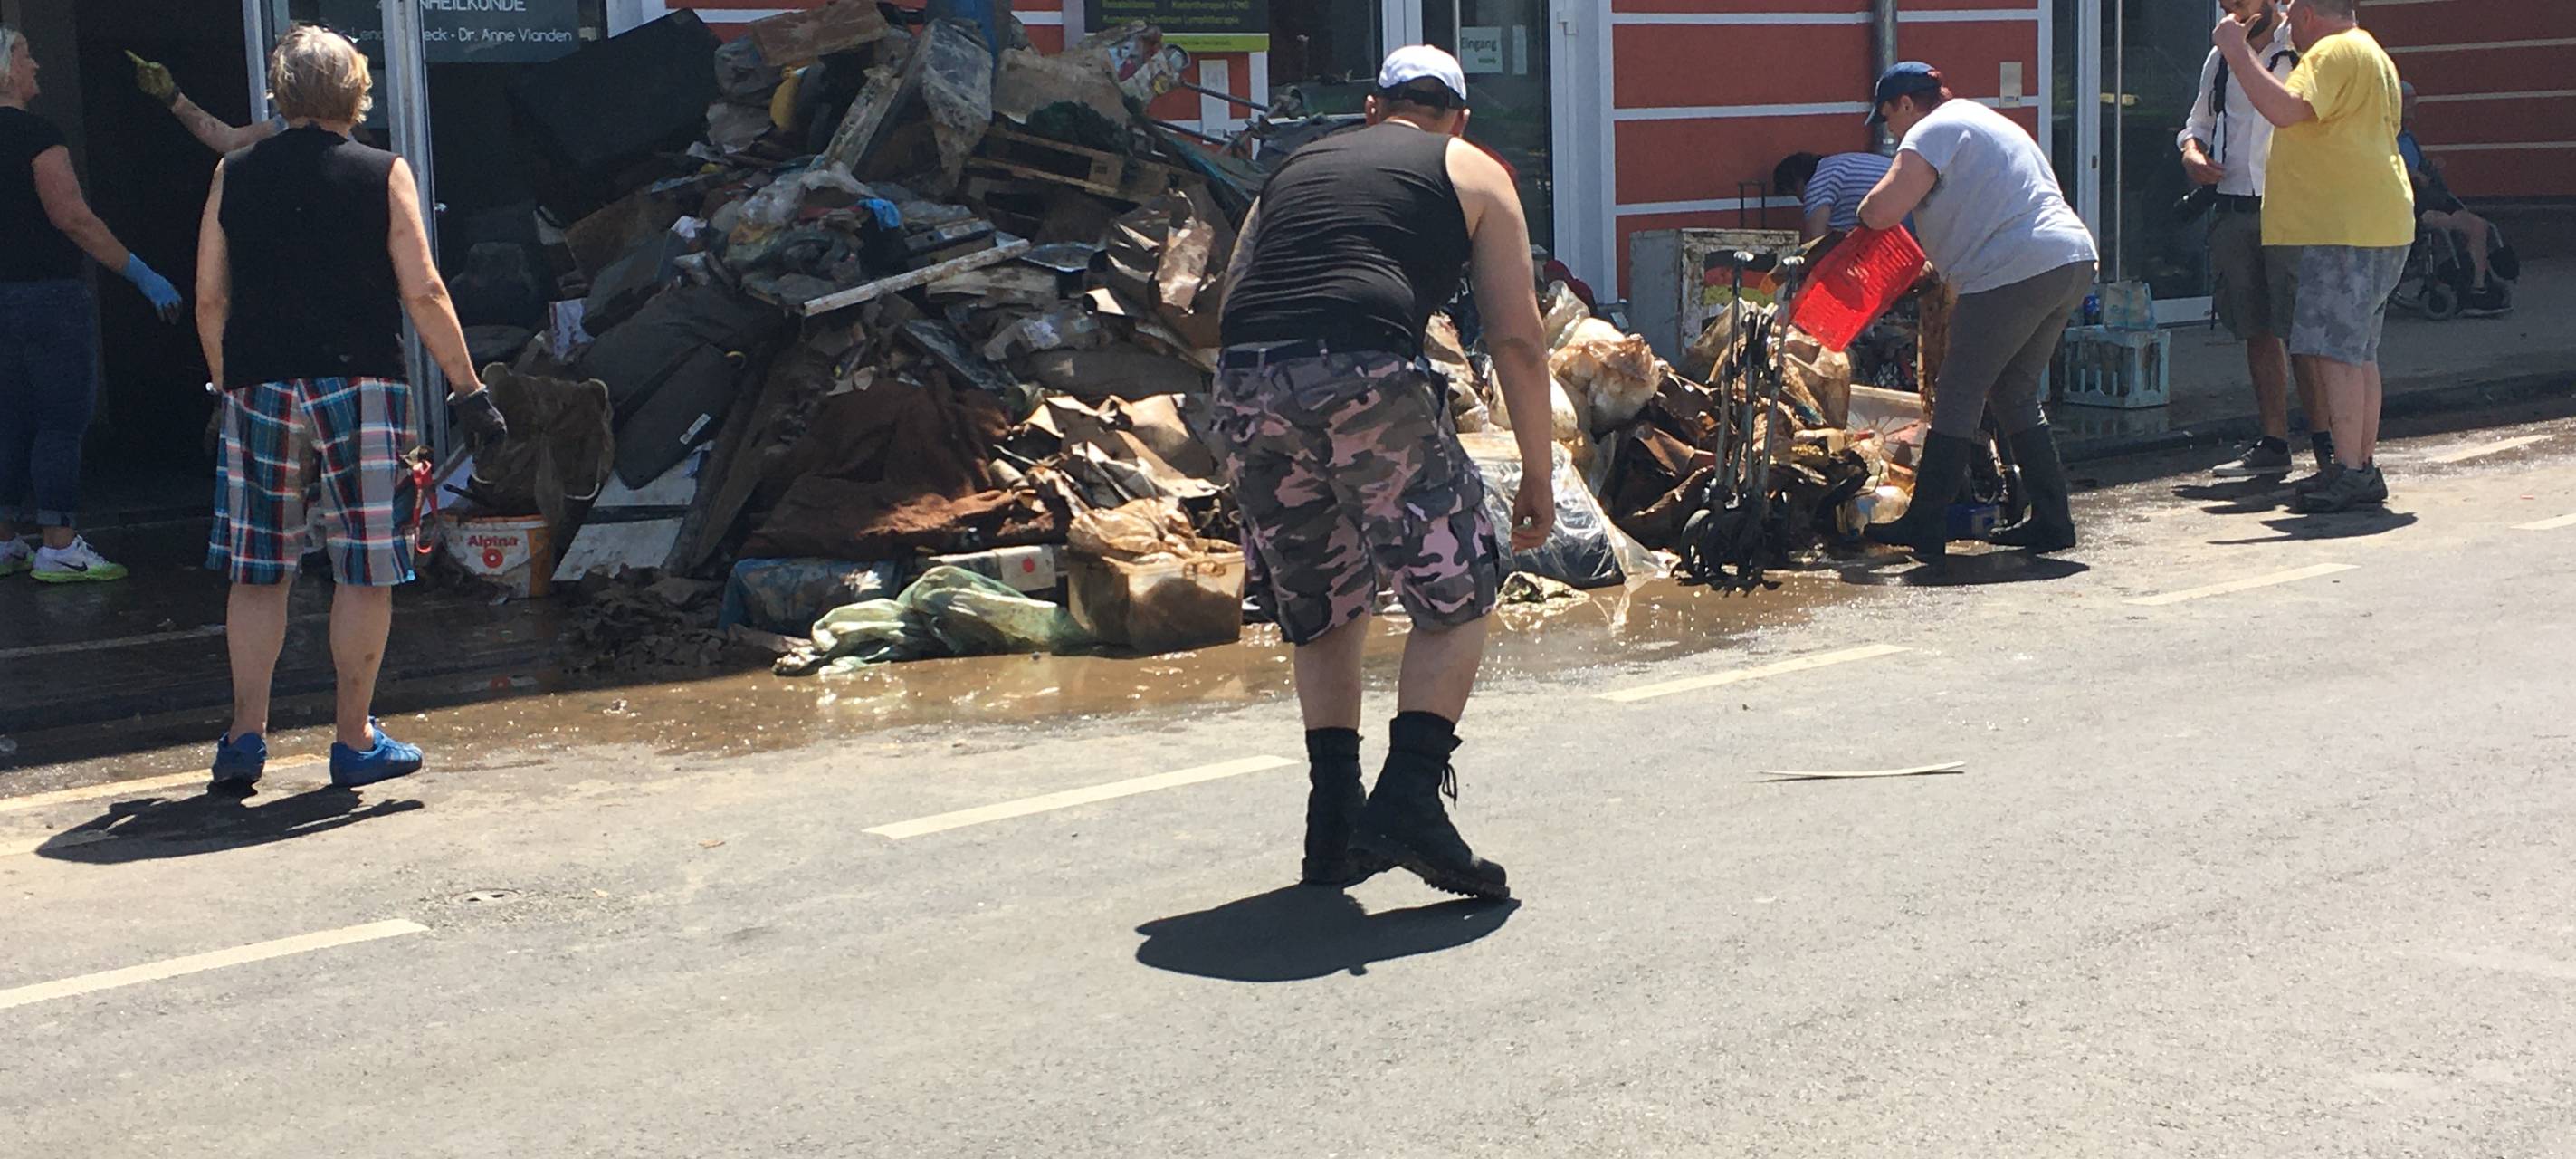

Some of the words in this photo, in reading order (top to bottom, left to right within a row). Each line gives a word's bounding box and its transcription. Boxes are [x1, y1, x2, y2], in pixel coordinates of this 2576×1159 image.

[458, 27, 478, 42] Dr.
[481, 28, 516, 42] Anne
[1460, 36, 1498, 53] Eingang
[468, 535, 518, 549] Alpina
